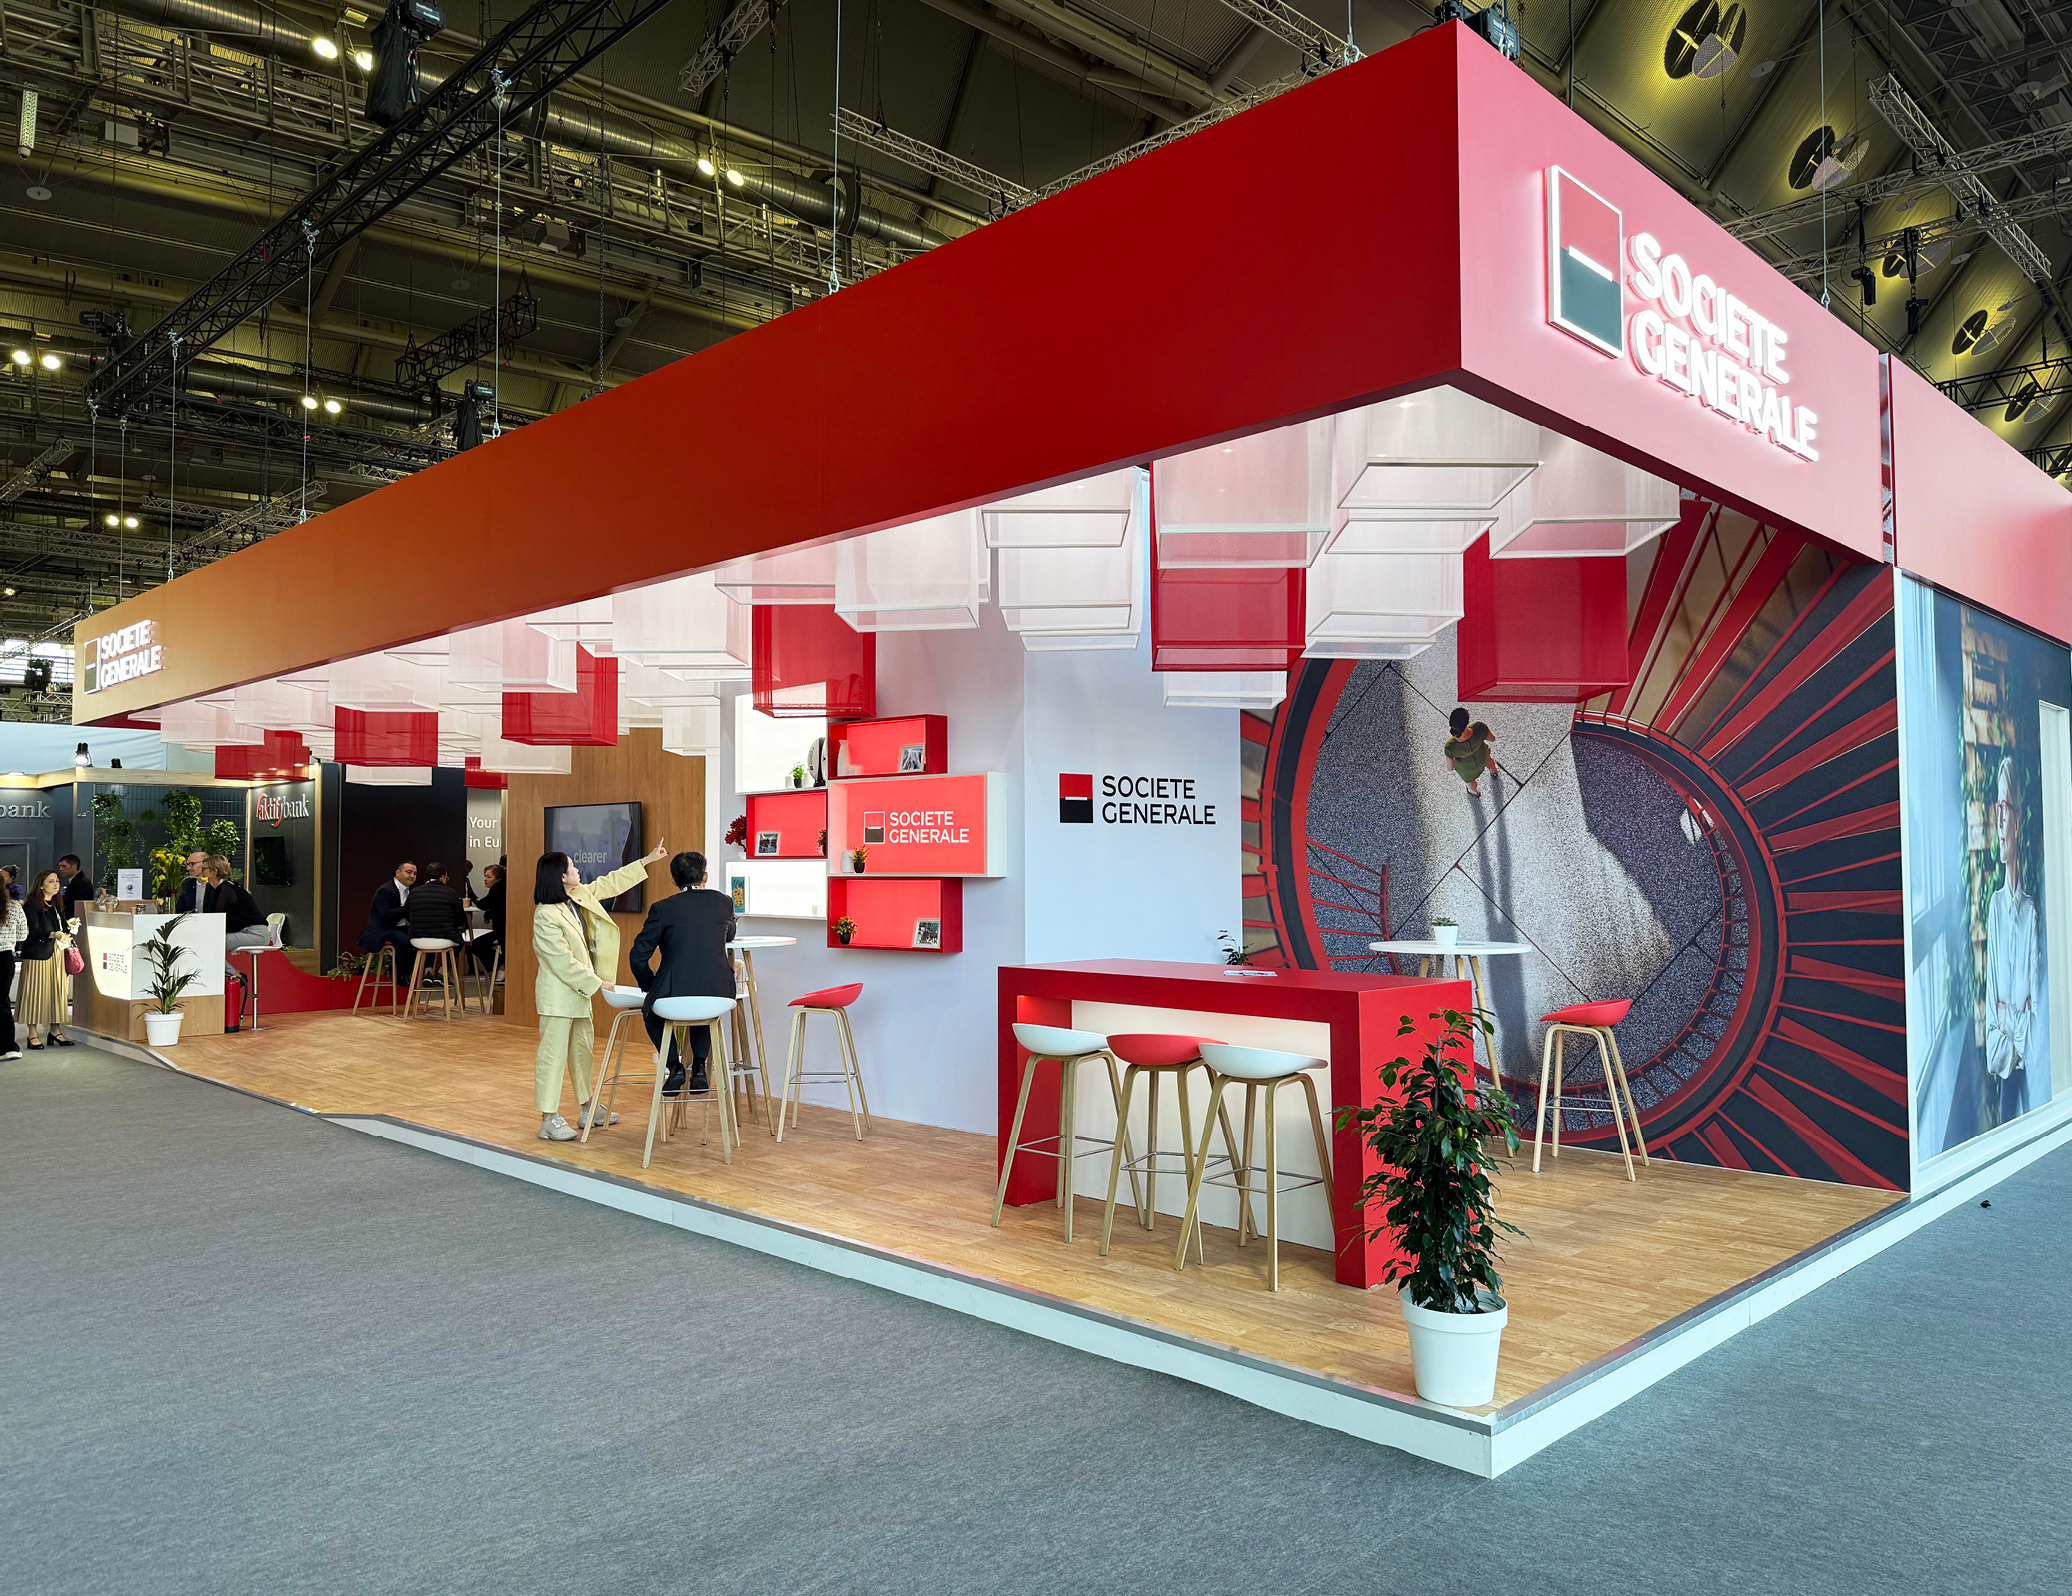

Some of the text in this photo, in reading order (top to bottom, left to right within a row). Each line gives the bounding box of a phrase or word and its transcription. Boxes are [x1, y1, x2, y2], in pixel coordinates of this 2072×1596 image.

[1630, 232, 1789, 384] SOCIETE
[1631, 310, 1819, 462] GENERALE
[101, 620, 152, 659] SOCIETE
[101, 645, 162, 687] GENERALE
[1102, 775, 1195, 799] SOCIETE
[469, 816, 498, 829] Your
[889, 811, 954, 826] SOCIETE
[1102, 802, 1216, 824] GENERALE
[469, 836, 502, 848] in Eu
[889, 829, 969, 843] GENERALE
[574, 850, 607, 864] clearer
